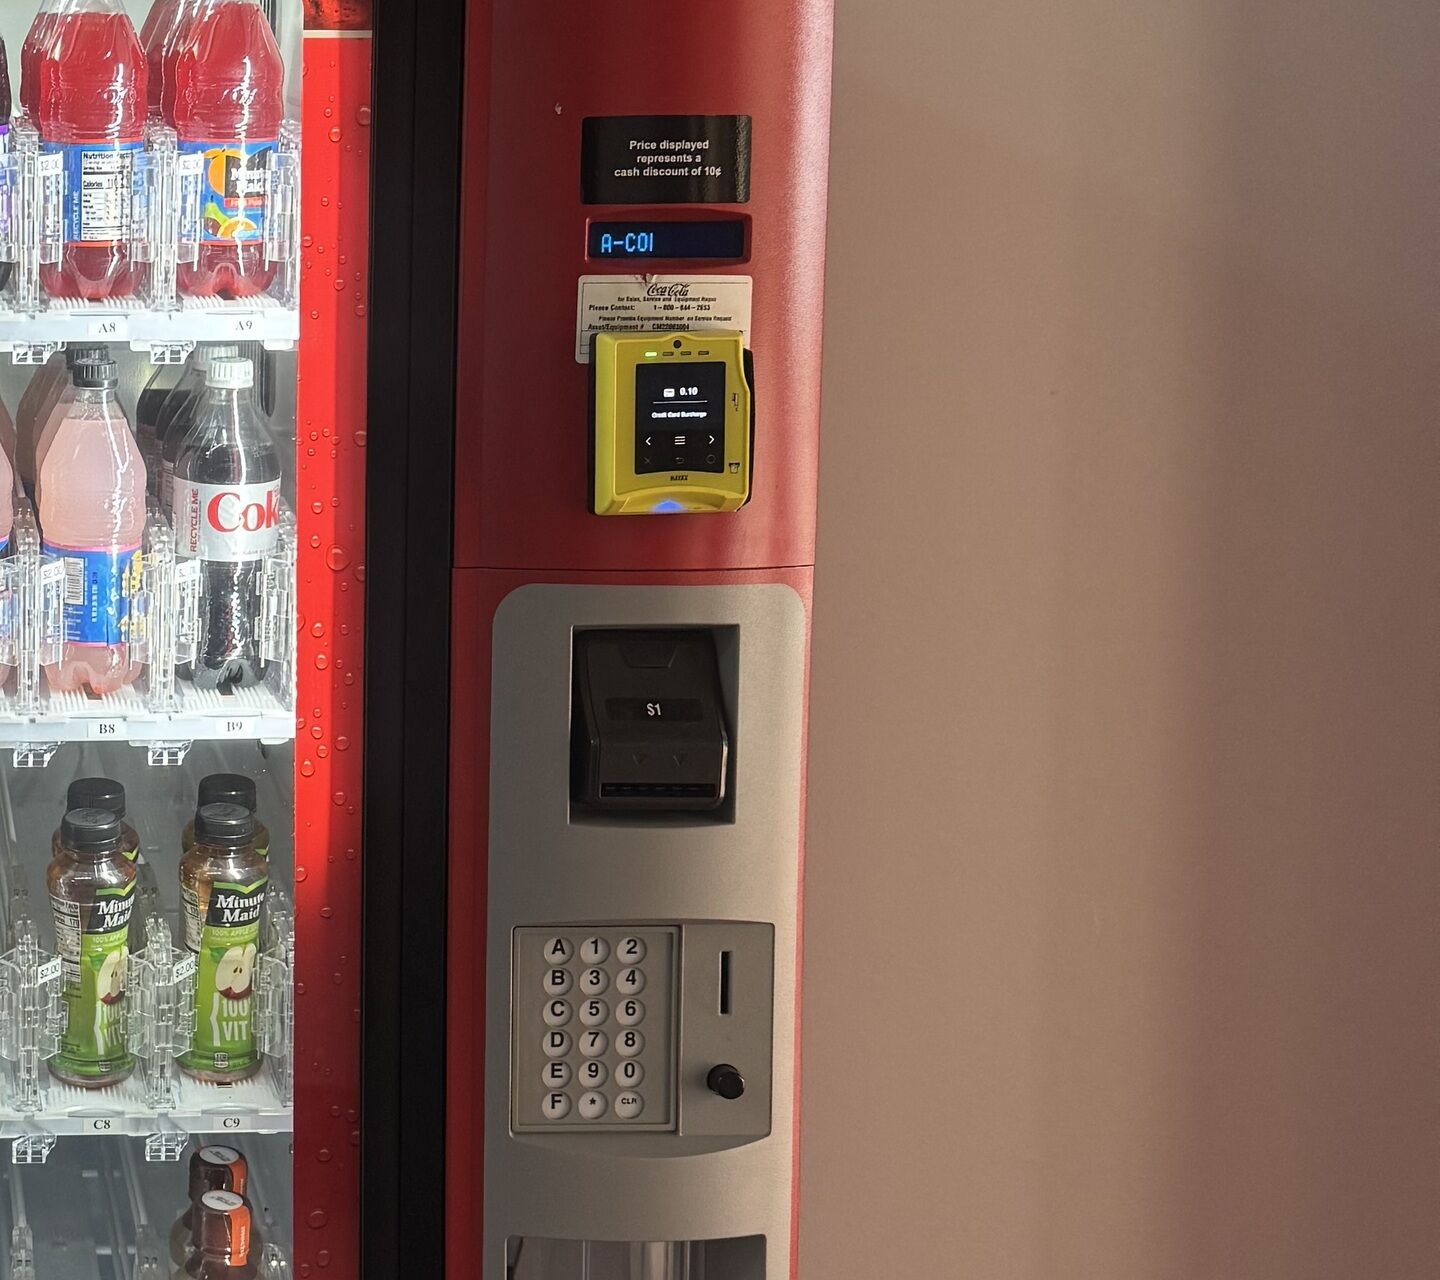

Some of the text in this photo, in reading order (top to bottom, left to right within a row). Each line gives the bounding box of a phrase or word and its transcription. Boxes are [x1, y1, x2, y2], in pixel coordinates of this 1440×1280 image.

[629, 140, 709, 152] Price displayed
[636, 153, 702, 164] represents a
[614, 166, 722, 178] cash discount of 10¢
[98, 322, 116, 333] A8
[235, 321, 253, 332] A9
[679, 386, 698, 396] 0.10
[207, 489, 280, 533] Cok
[189, 488, 199, 552] RECYCLE ME
[646, 702, 662, 716] S1
[99, 723, 115, 734] B8
[227, 720, 243, 732] B9
[222, 905, 260, 924] Maid
[550, 939, 566, 955] A
[590, 939, 600, 954] 1
[624, 939, 638, 954] 2
[40, 963, 60, 980] $2.00
[175, 960, 194, 978] $2.00
[550, 970, 566, 986] B
[588, 970, 601, 985] 3
[624, 970, 637, 985] 4
[550, 1001, 566, 1017] C
[589, 1001, 601, 1016] 5
[624, 1001, 638, 1016] 6
[223, 1020, 247, 1042] VIT
[550, 1032, 566, 1048] D
[589, 1032, 601, 1047] 7
[624, 1032, 638, 1047] 8
[550, 1063, 566, 1079] E
[589, 1063, 601, 1078] 9
[624, 1063, 638, 1078] 0
[551, 1094, 638, 1110] F CLR
[93, 1118, 111, 1130] C8
[223, 1117, 240, 1128] C9
